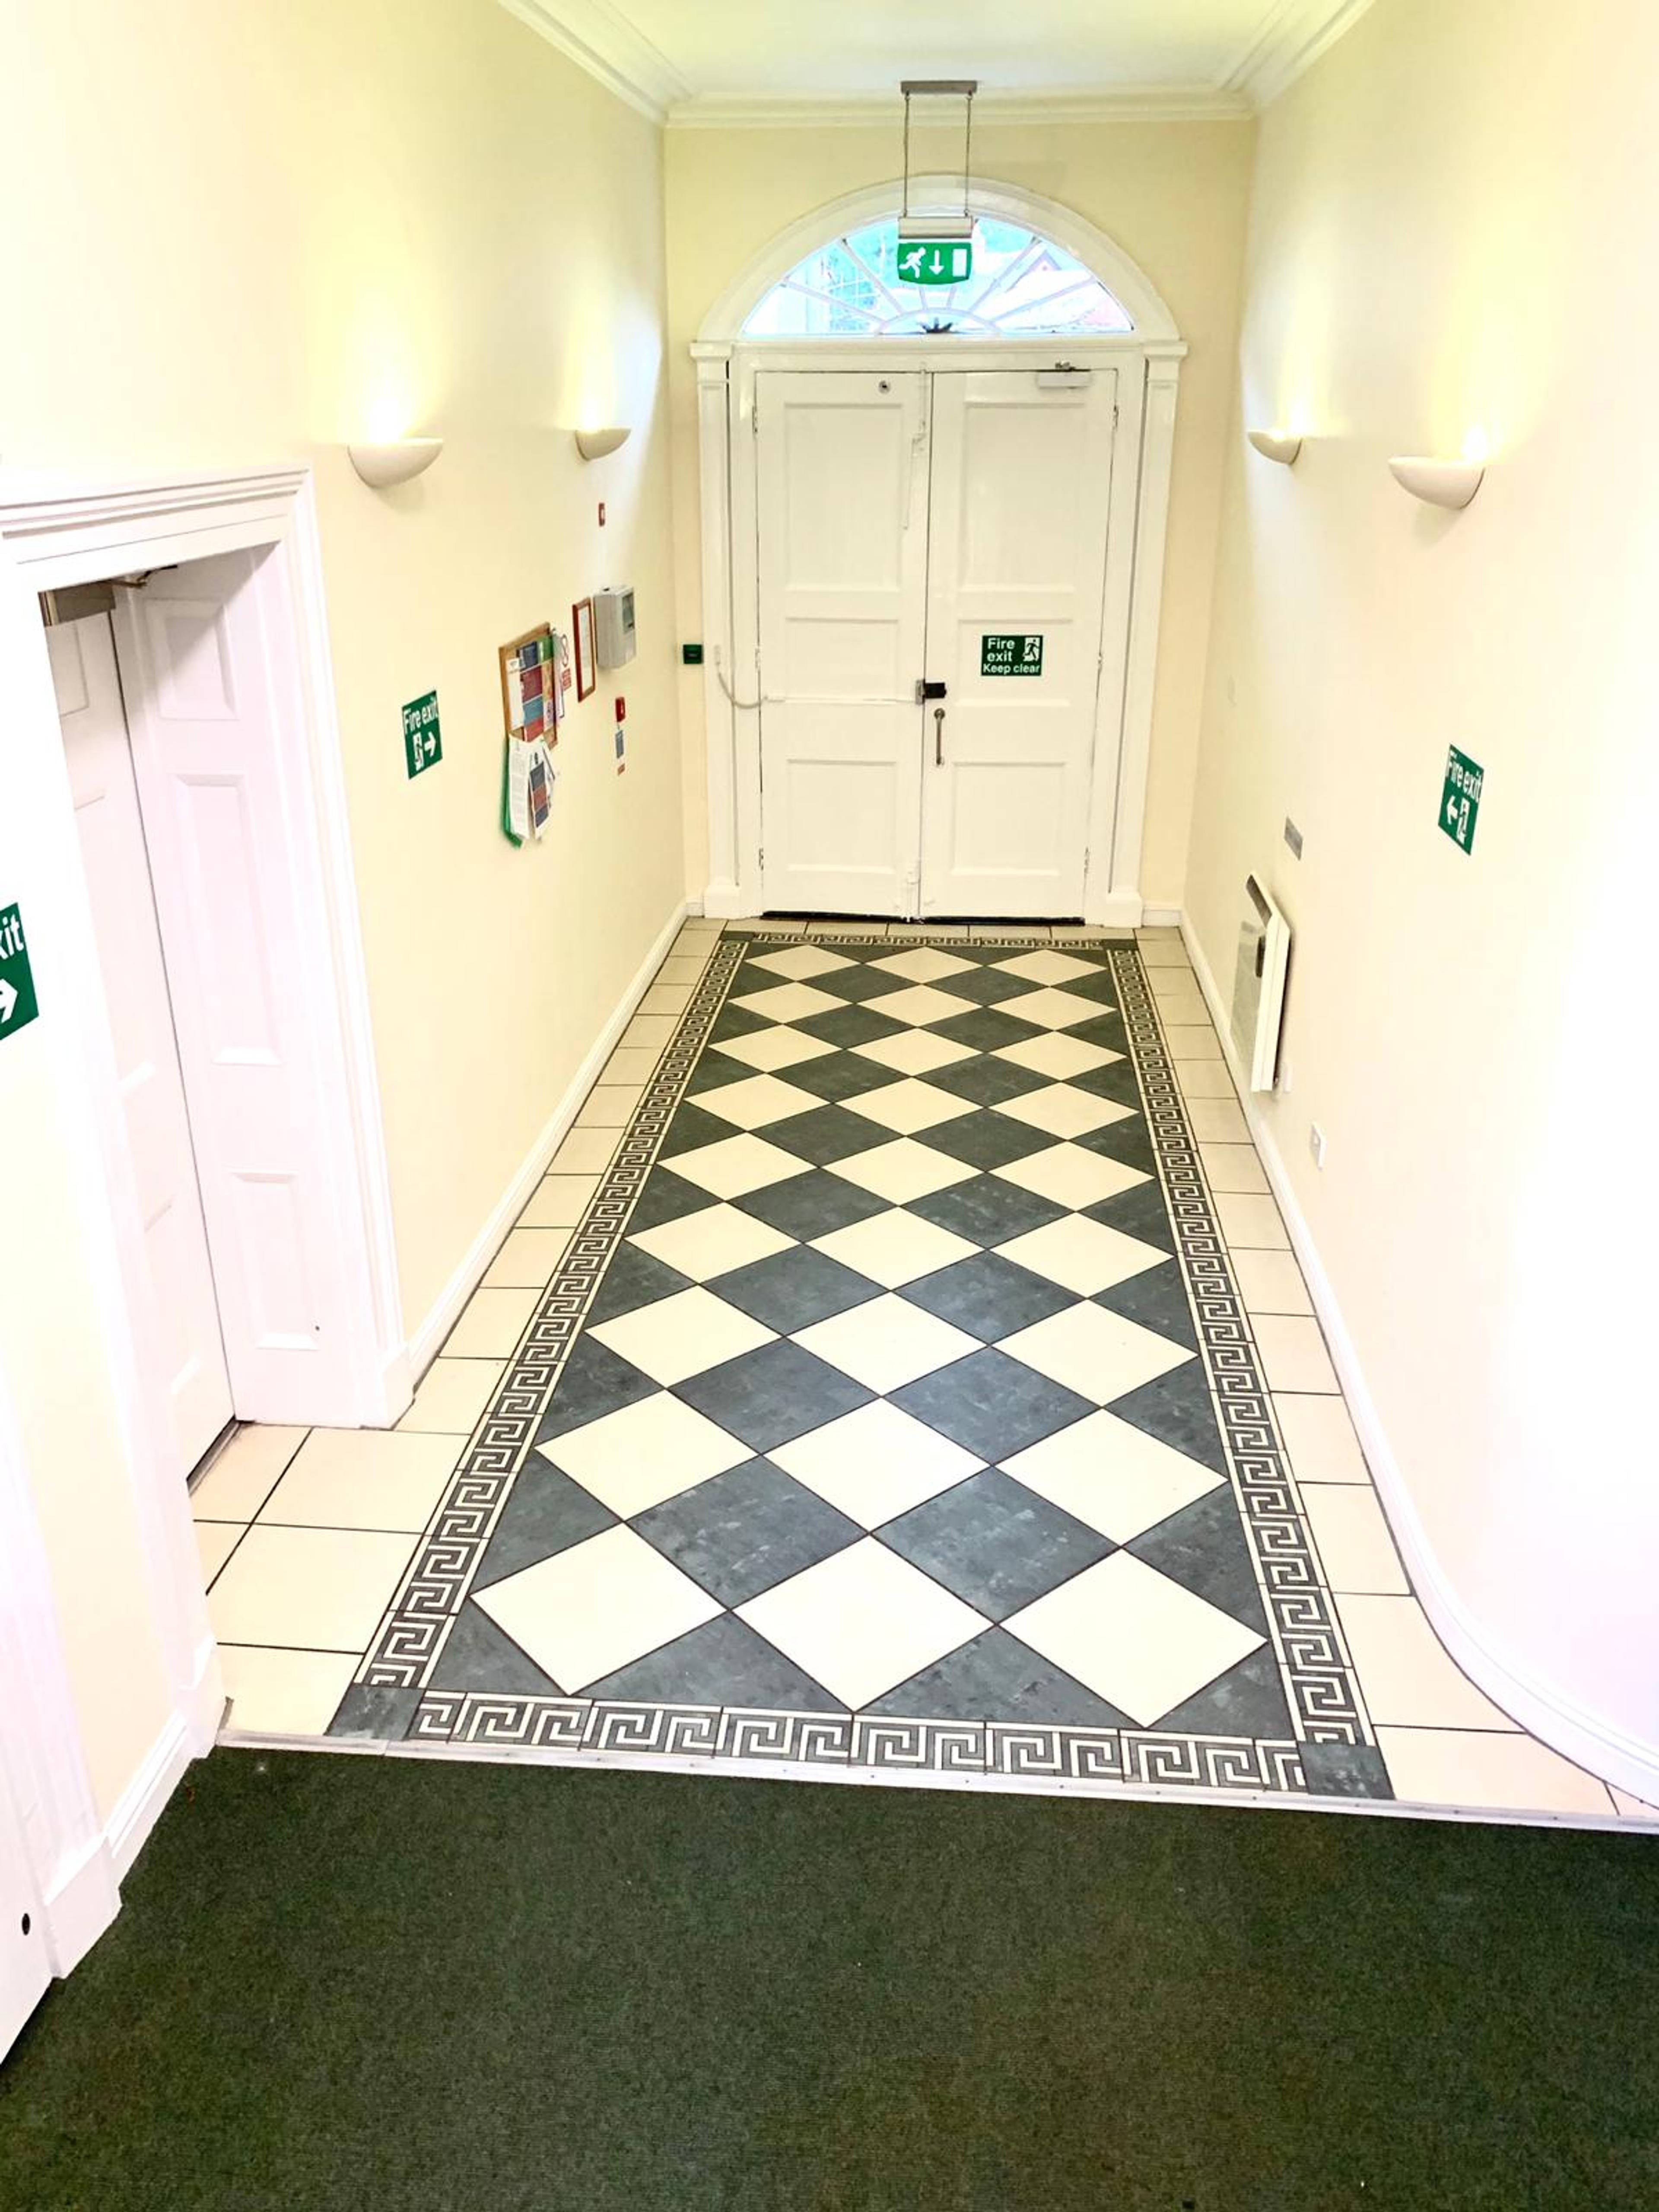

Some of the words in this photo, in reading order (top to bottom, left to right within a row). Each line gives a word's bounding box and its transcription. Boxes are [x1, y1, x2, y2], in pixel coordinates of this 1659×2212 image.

[988, 637, 1015, 649] Fire
[987, 651, 1013, 662] exit
[983, 663, 1011, 675] Keep
[1013, 664, 1040, 673] clear
[404, 708, 421, 734] Fire
[421, 696, 438, 725] exit
[1446, 750, 1463, 788] Fire
[1462, 771, 1482, 803] exit
